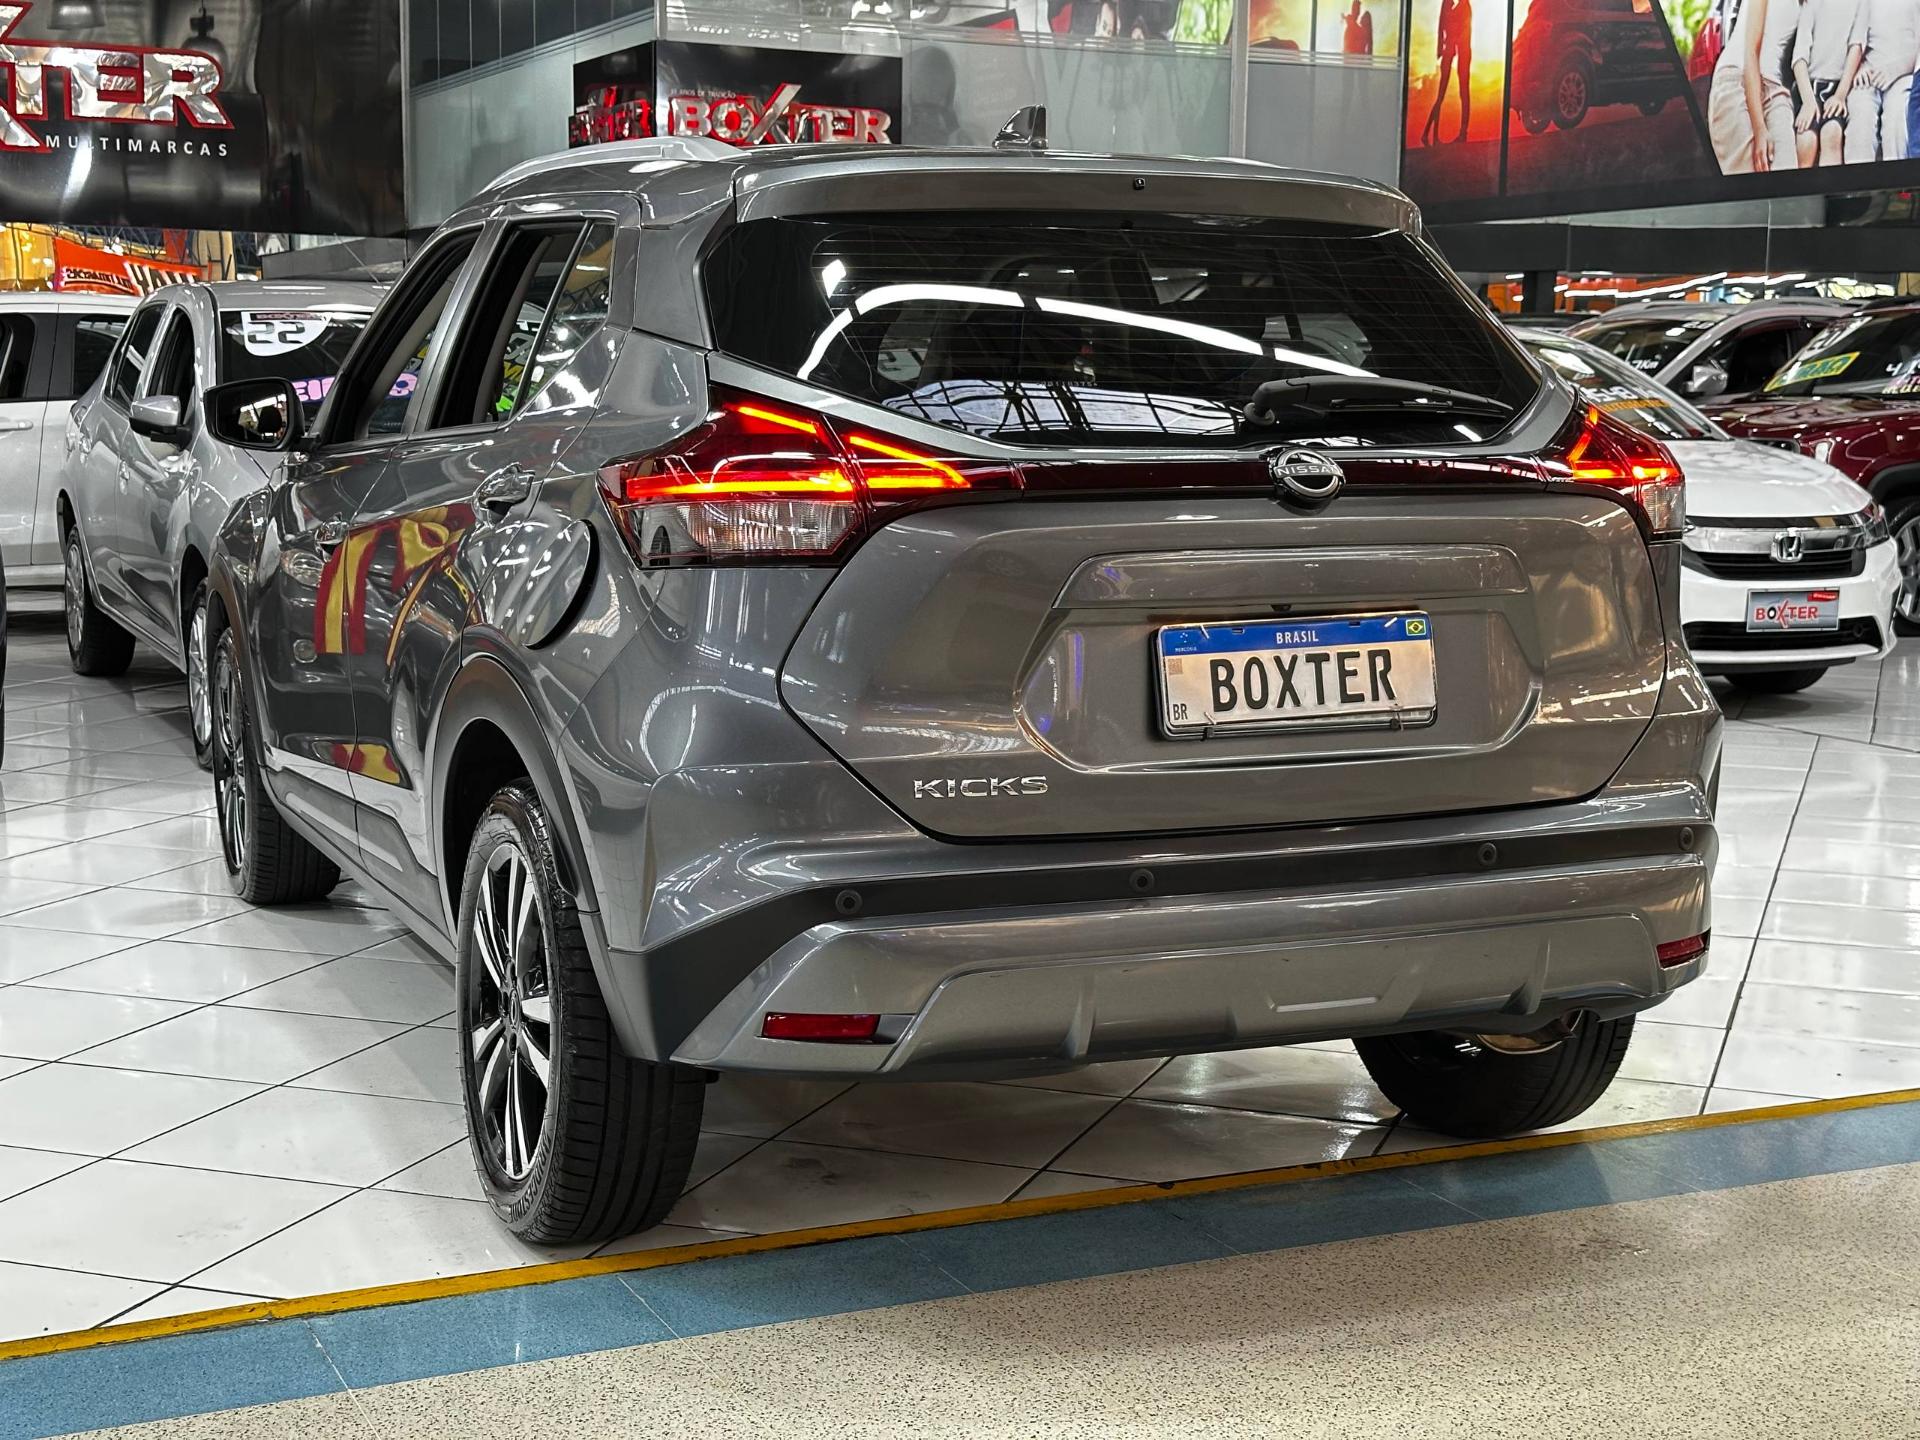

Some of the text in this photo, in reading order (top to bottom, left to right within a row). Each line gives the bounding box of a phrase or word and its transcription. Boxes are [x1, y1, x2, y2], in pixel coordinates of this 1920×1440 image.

[668, 82, 892, 145] BOXTER
[45, 134, 228, 157] MULTIMARCAS
[1754, 600, 1820, 629] BOXTER
[1276, 630, 1320, 644] BRASIL
[1209, 648, 1396, 713] BOXTER
[1172, 703, 1188, 720] BR
[913, 775, 1049, 799] KICKS
